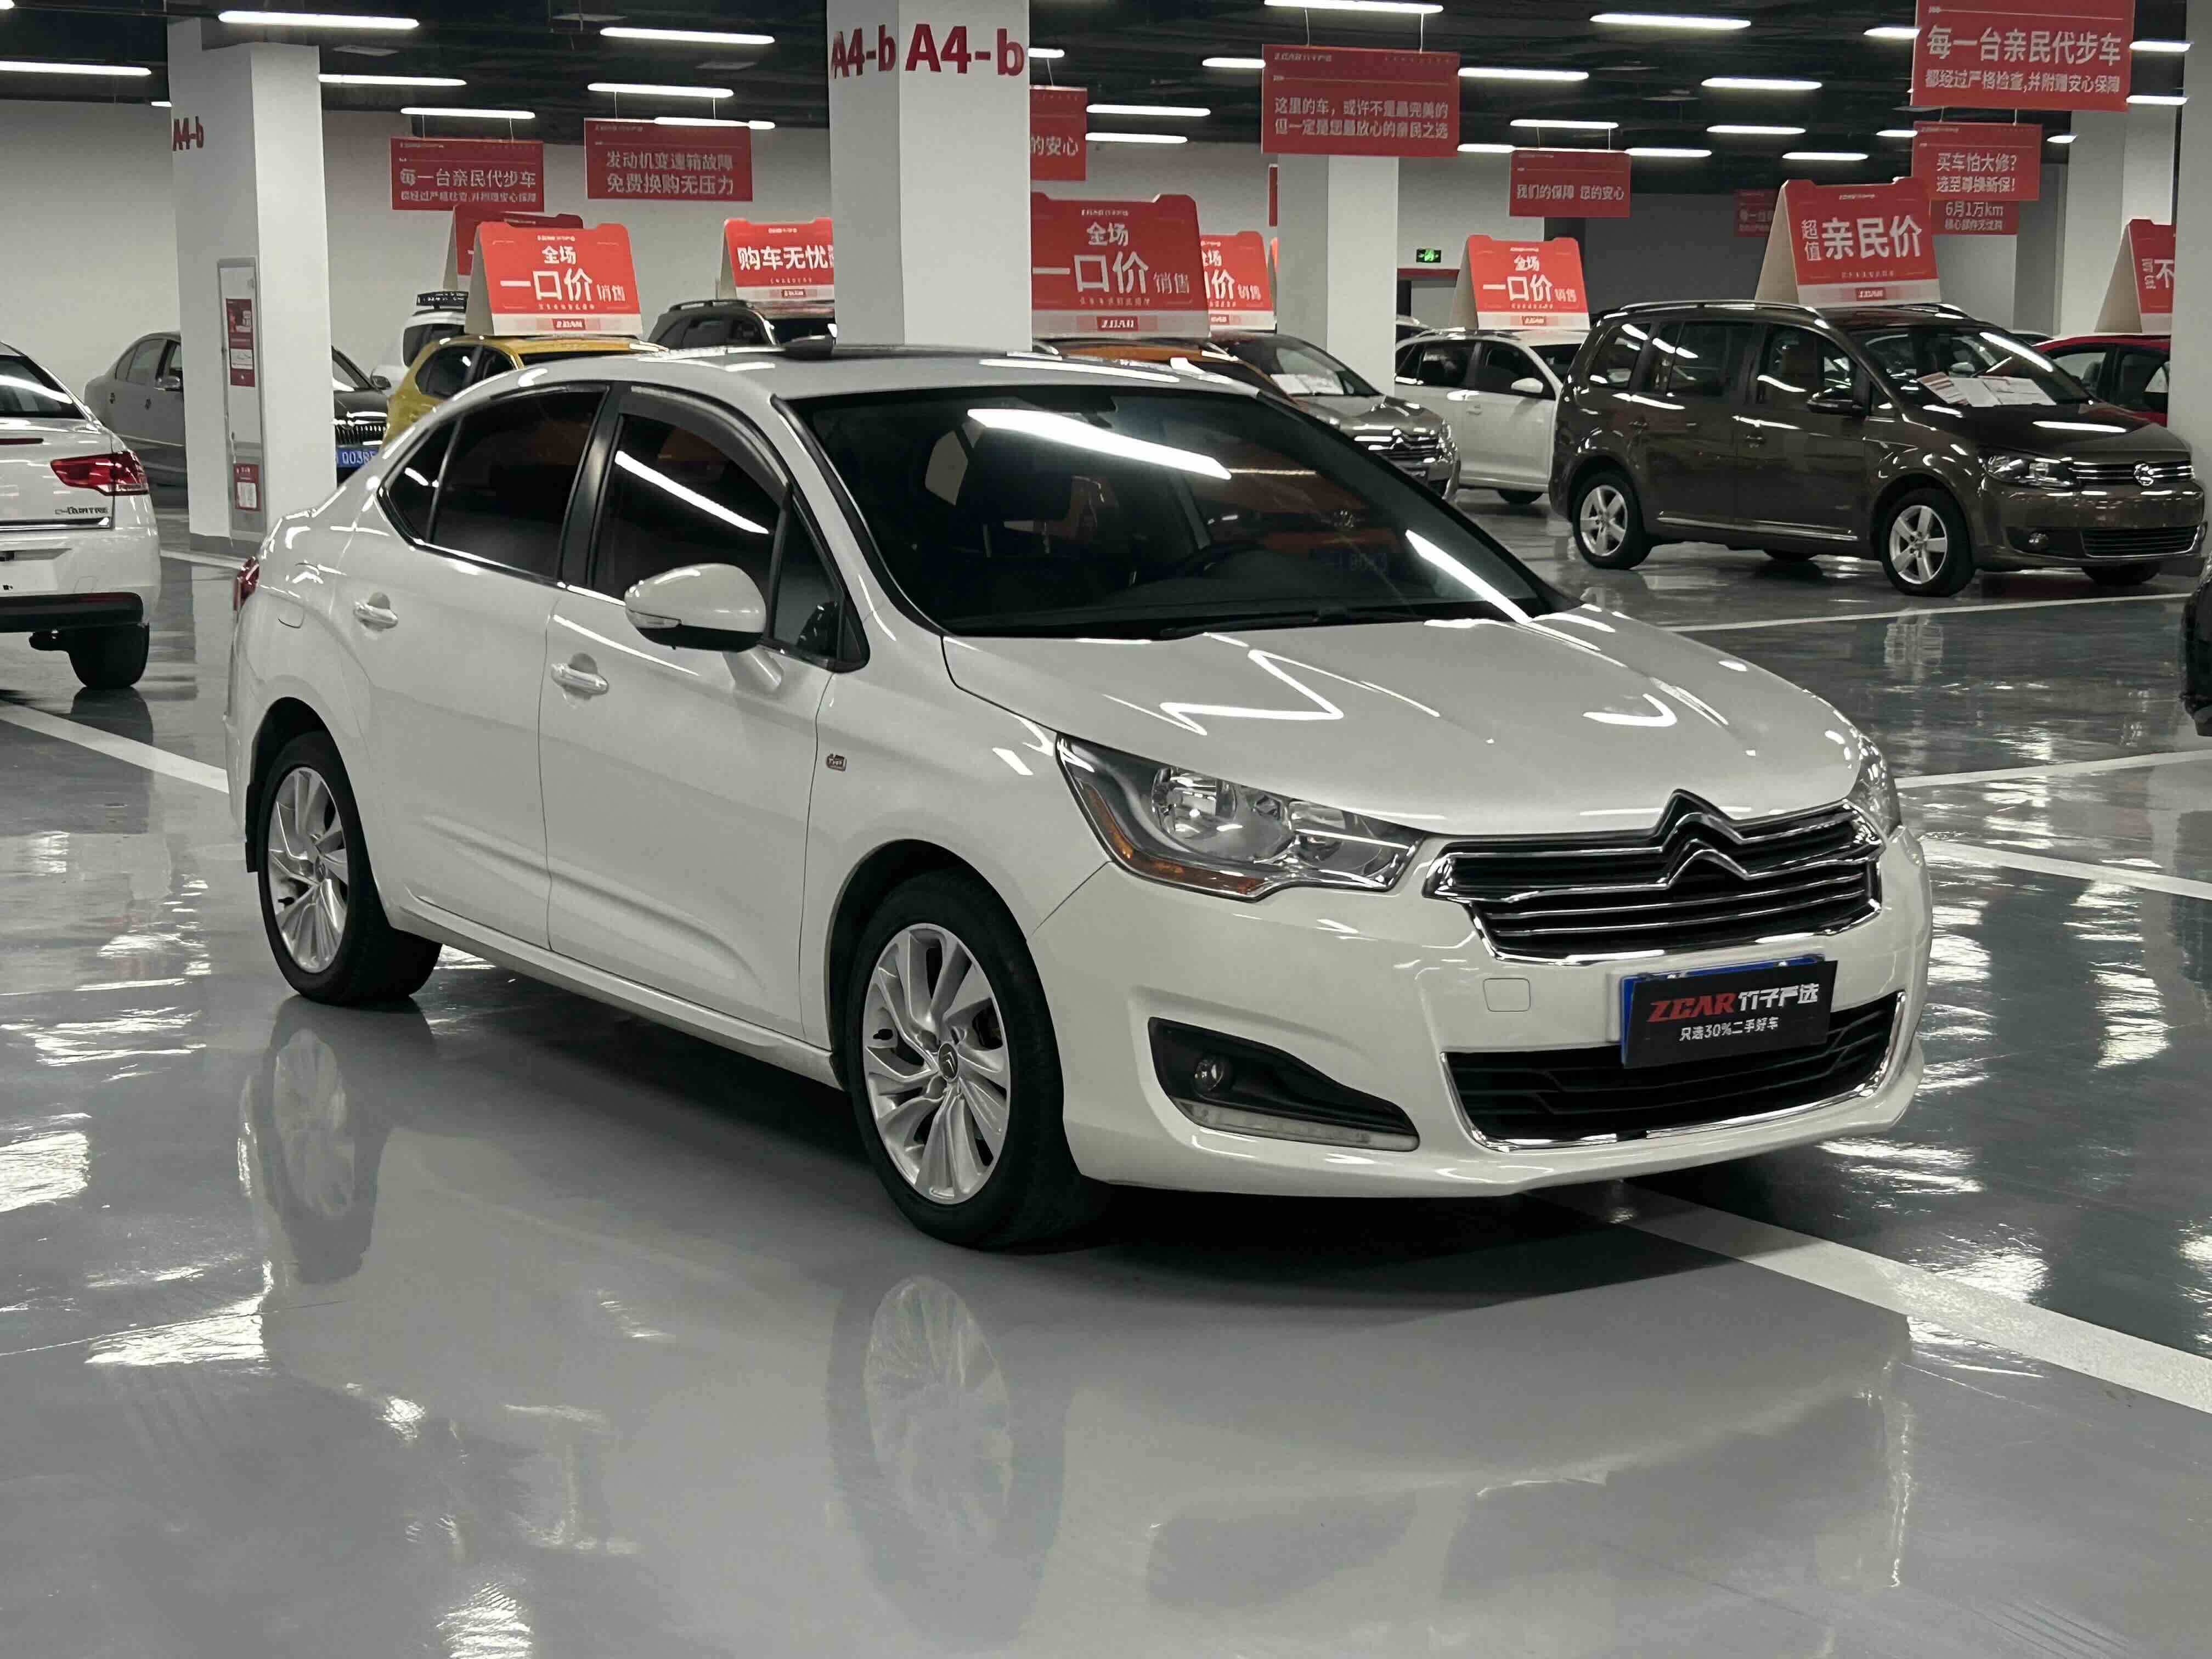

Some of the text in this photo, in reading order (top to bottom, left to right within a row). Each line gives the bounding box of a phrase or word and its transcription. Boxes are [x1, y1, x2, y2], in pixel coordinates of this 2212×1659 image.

[831, 24, 897, 79] A4-b
[905, 24, 1025, 76] A4-b
[1927, 25, 2122, 66] 每一台亲民代步车
[606, 150, 733, 171] 发动机变速箱故障
[1936, 153, 2017, 172] 买车怕大修?
[400, 168, 537, 188] 每一台亲民代步车
[607, 173, 734, 195] 免费换购无压力
[1086, 222, 1129, 246] 全场
[1821, 215, 1922, 260] 亲民价
[542, 245, 577, 264] 全场
[500, 268, 593, 302] 一口价
[1032, 251, 1149, 294] 一口价
[1482, 274, 1553, 302] 一口价
[1646, 993, 1738, 1023] ZCAR
[1679, 1017, 1779, 1042] 只选30%二手好车
